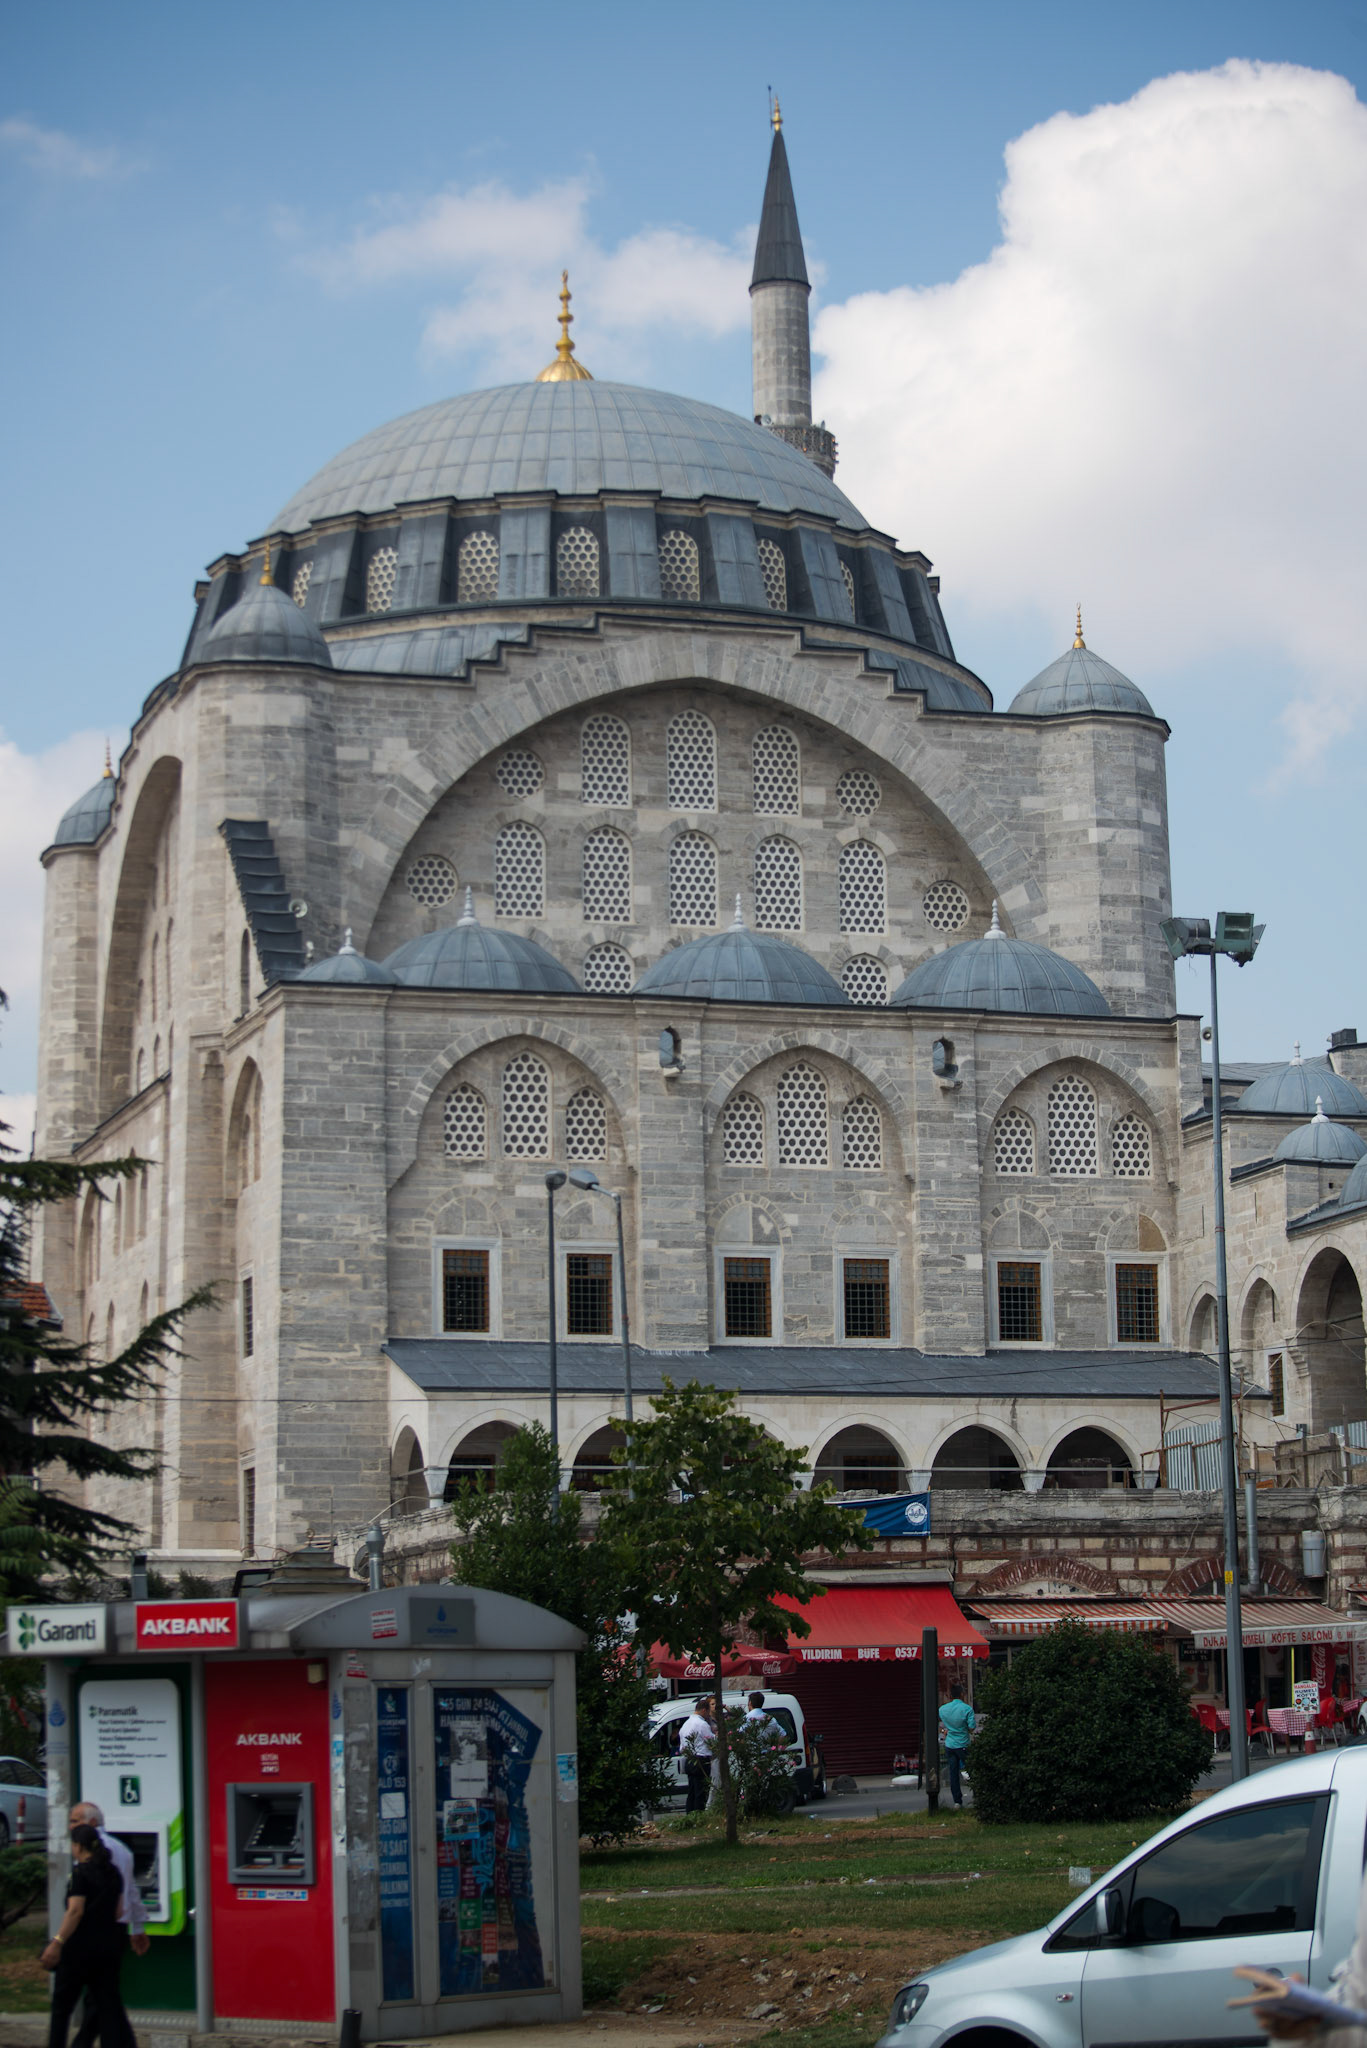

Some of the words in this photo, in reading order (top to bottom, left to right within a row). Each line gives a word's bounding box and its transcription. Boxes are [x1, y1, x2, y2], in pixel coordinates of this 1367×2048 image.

[38, 1619, 96, 1642] Garanti
[142, 1617, 231, 1636] AKBANK
[1242, 1632, 1266, 1645] UMELİ
[1301, 1630, 1333, 1642] SALONU
[801, 1648, 843, 1660] YILDIRIM
[858, 1647, 880, 1659] BÜFE
[895, 1647, 918, 1658] 0537
[944, 1646, 956, 1657] 53
[961, 1646, 973, 1657] 56
[684, 1663, 715, 1677] Coca-Col
[236, 1732, 302, 1746] AKBANK
